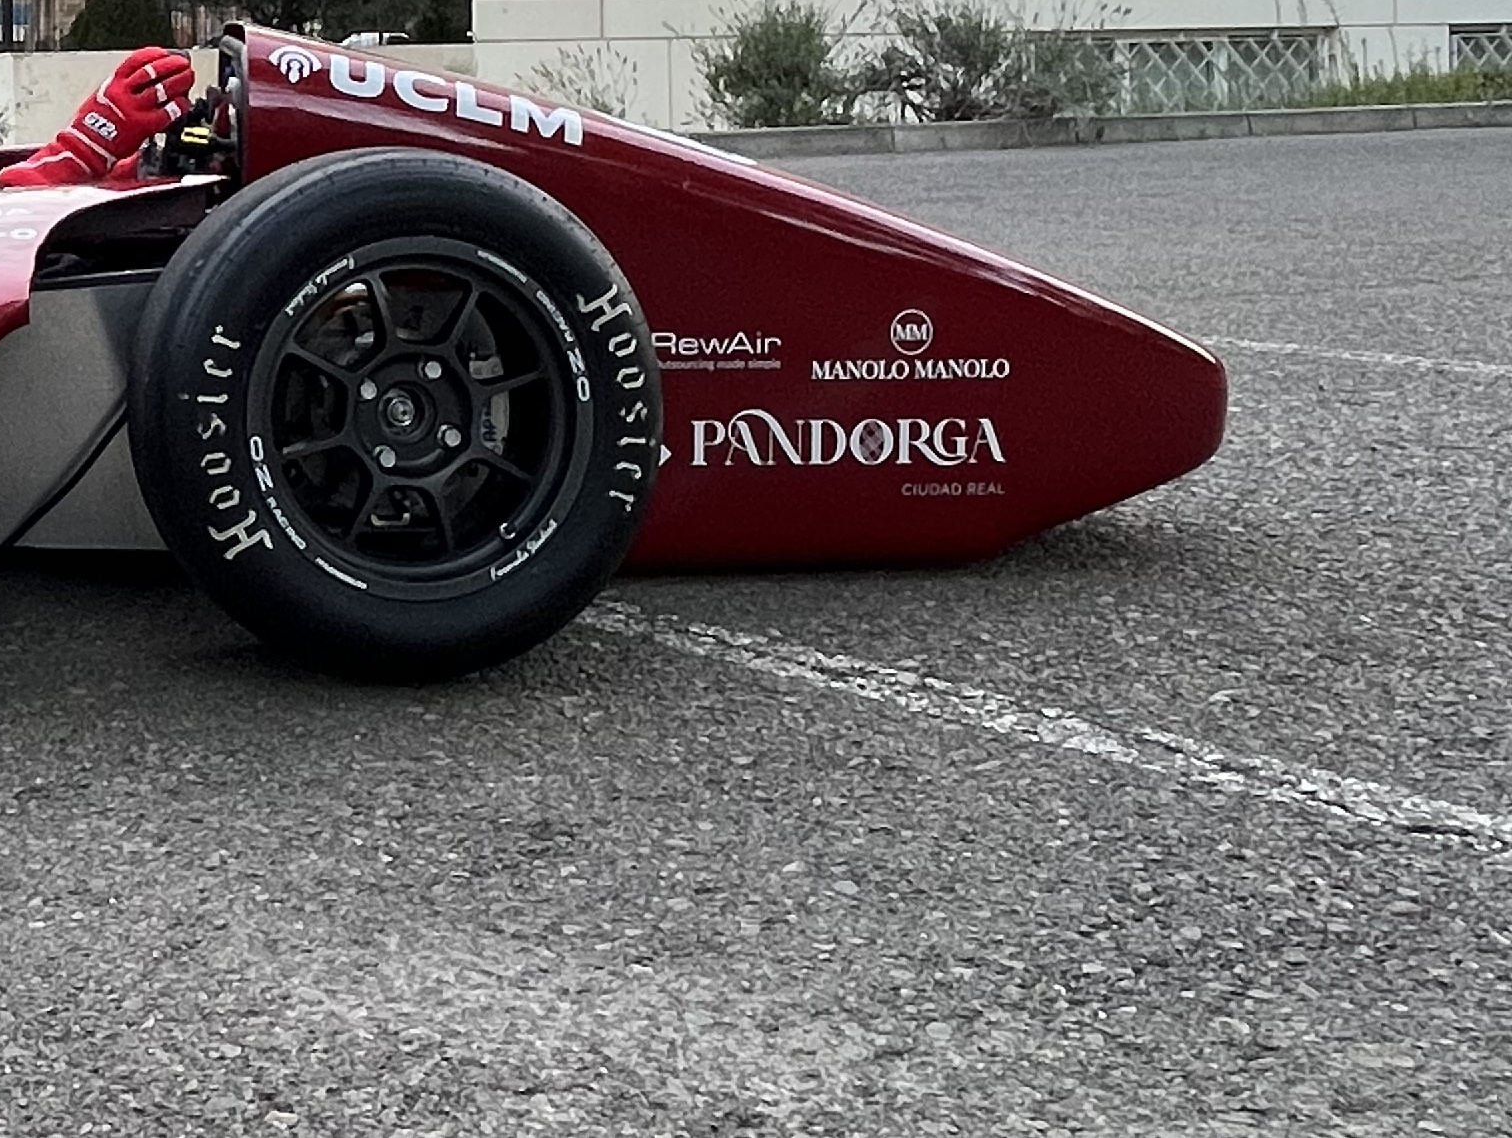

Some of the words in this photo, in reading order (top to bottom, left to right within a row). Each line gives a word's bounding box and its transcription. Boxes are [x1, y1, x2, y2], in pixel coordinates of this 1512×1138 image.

[329, 54, 584, 146] UCLM
[651, 331, 782, 355] RewAir
[811, 359, 910, 380] MANOLO
[914, 358, 1010, 379] MANOLO
[576, 283, 655, 513] Hoosier
[185, 325, 274, 560] Hoosier
[690, 409, 1007, 466] PANDORGA
[249, 436, 275, 492] OZ
[267, 497, 307, 550] RACING
[901, 483, 962, 496] CIUDAD
[966, 482, 1005, 495] REAL
